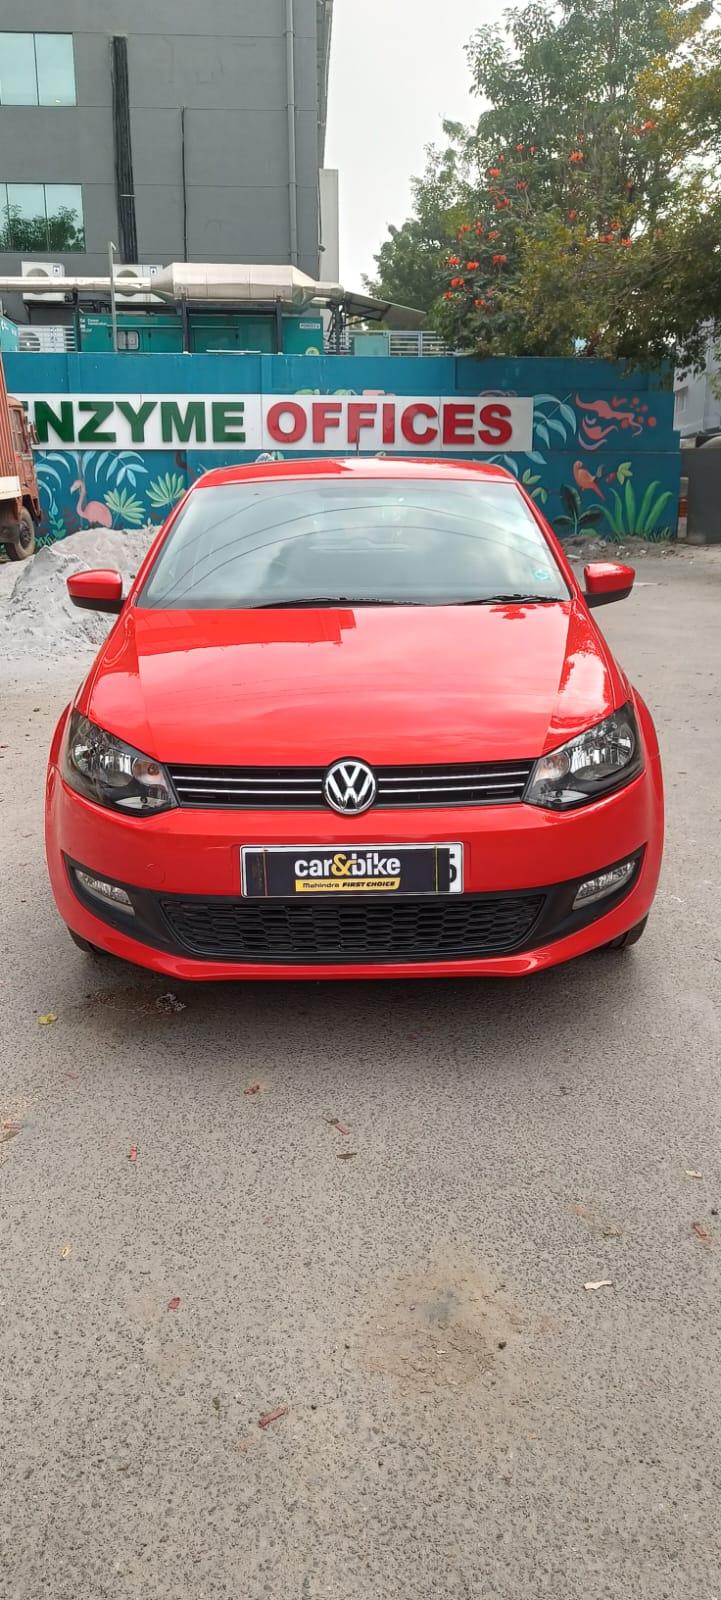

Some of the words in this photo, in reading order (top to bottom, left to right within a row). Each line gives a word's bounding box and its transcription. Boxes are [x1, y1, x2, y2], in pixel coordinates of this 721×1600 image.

[266, 401, 513, 445] OFFICES
[294, 853, 401, 877] car&bike
[366, 880, 396, 888] CHOICE
